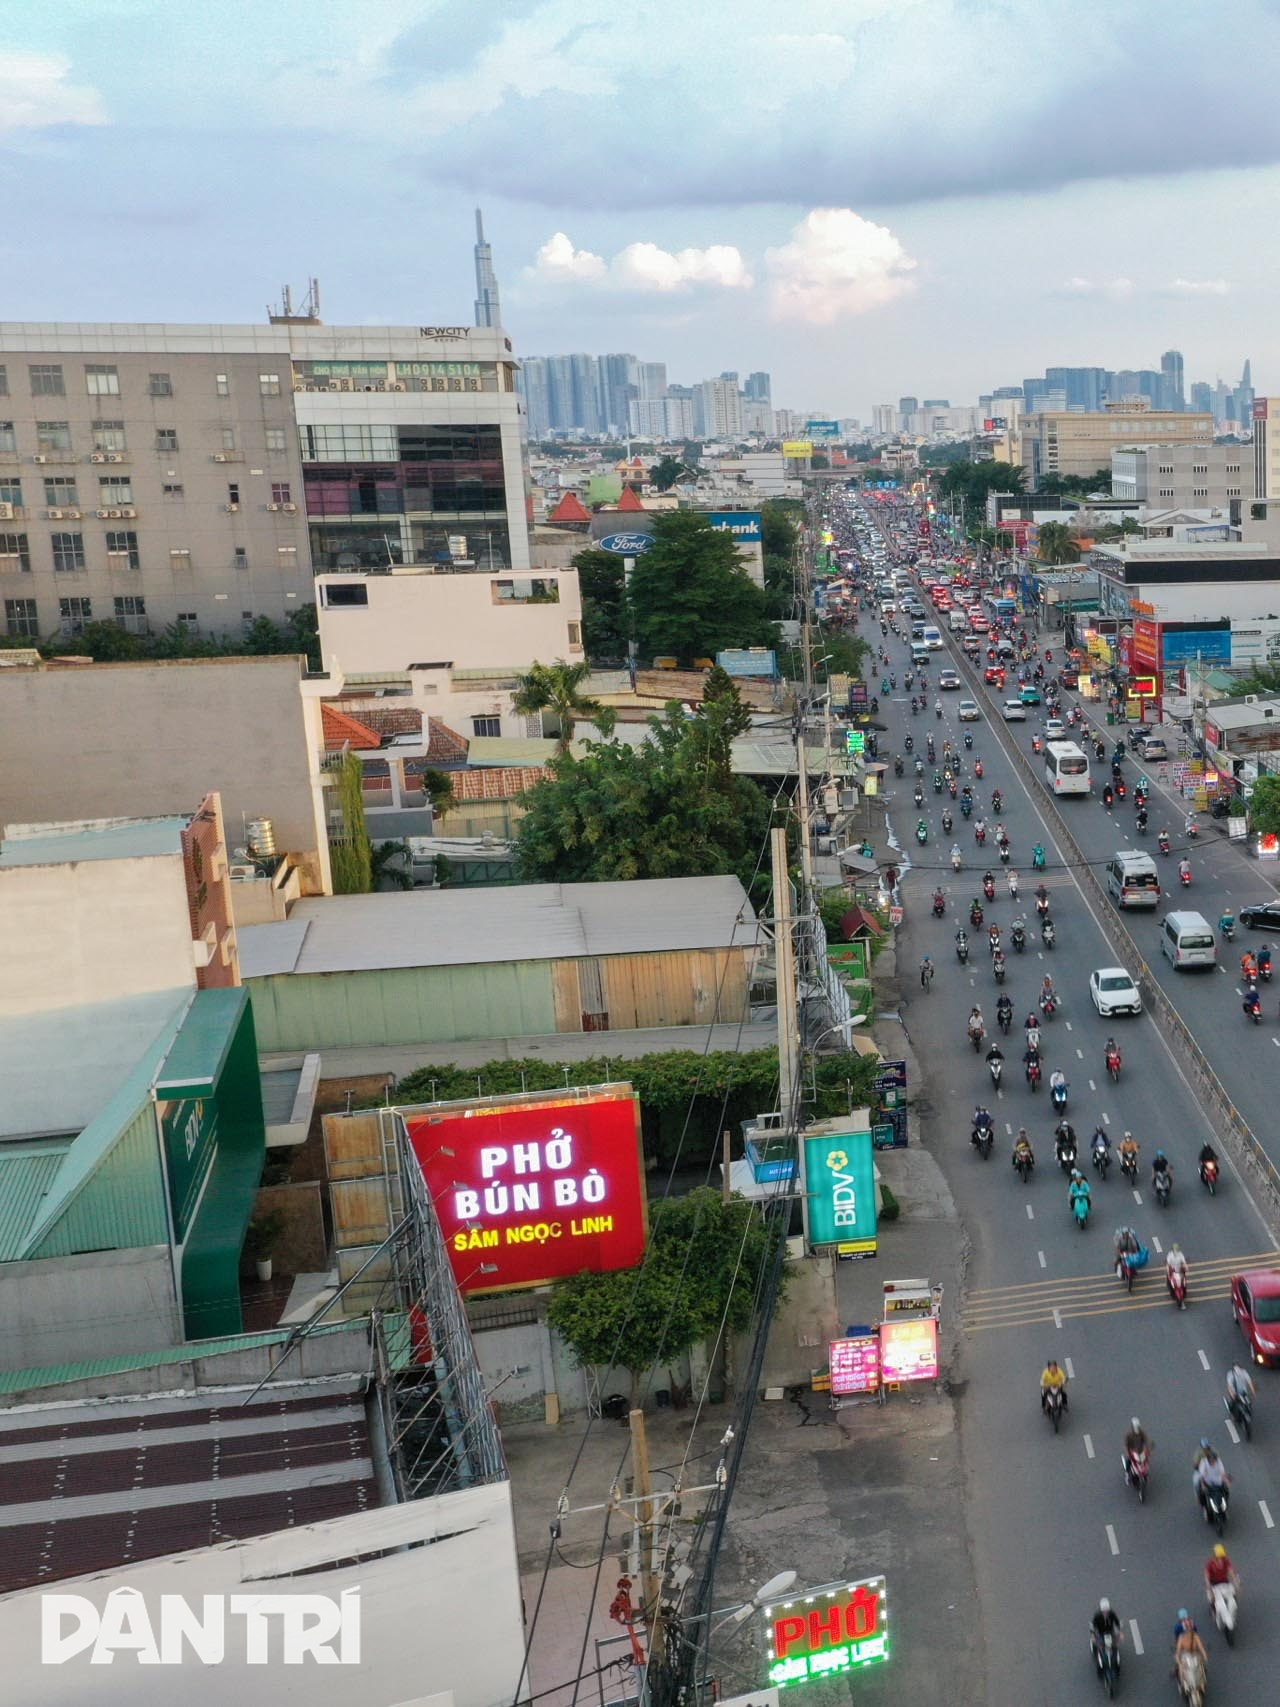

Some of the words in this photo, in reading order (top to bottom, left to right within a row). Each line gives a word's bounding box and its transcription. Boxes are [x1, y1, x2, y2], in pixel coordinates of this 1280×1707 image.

[611, 535, 647, 550] Ford
[480, 1127, 573, 1179] PHỞ
[454, 1180, 541, 1219] BÚN
[553, 1168, 606, 1206] BÒ
[831, 1170, 857, 1227] BIDV
[454, 1228, 499, 1251] SÂM
[505, 1221, 563, 1244] NGỌC
[571, 1215, 613, 1236] LINH
[773, 1586, 880, 1659] PHỞ
